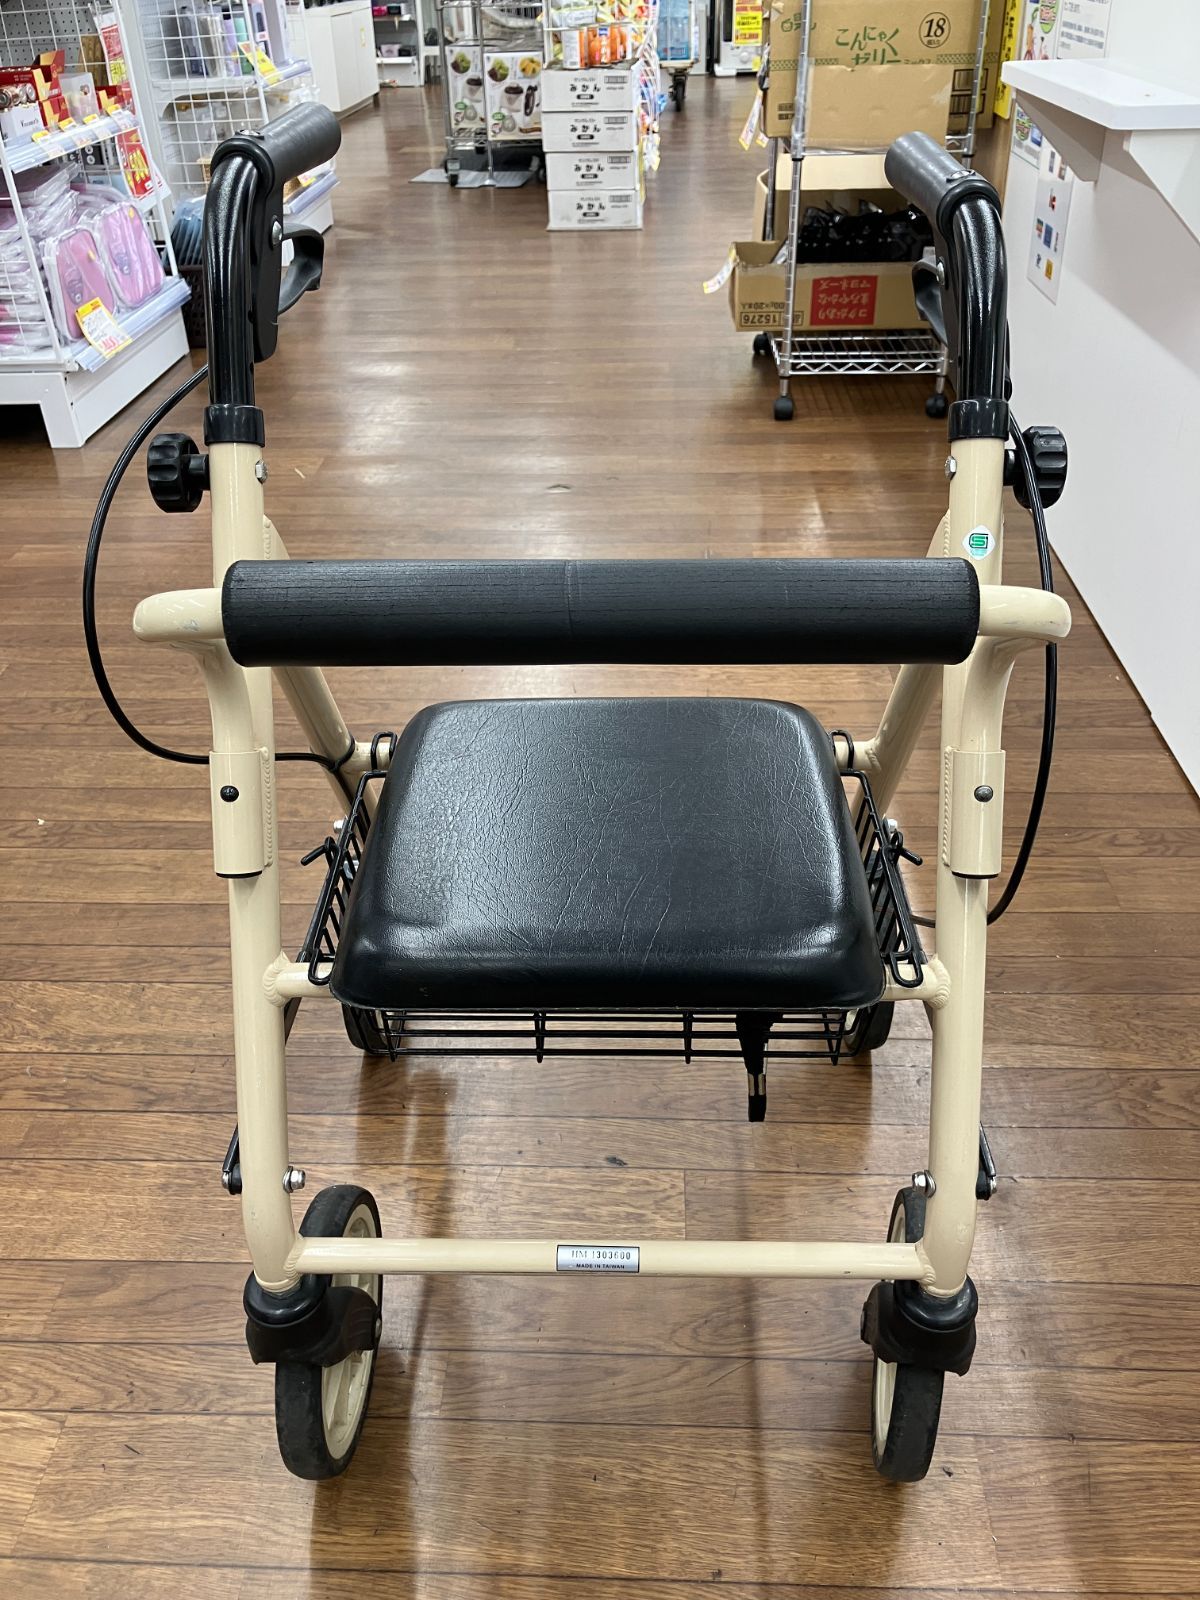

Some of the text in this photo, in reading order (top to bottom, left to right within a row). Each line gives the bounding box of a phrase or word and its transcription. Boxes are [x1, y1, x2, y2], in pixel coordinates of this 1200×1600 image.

[923, 18, 946, 38] 18
[835, 25, 899, 56] こんにゃく
[851, 48, 901, 65] ゼリー
[820, 278, 871, 290] マヨネーズ
[818, 292, 869, 305] まろやかな
[743, 314, 777, 324] 15276
[818, 307, 867, 320] コクがあり
